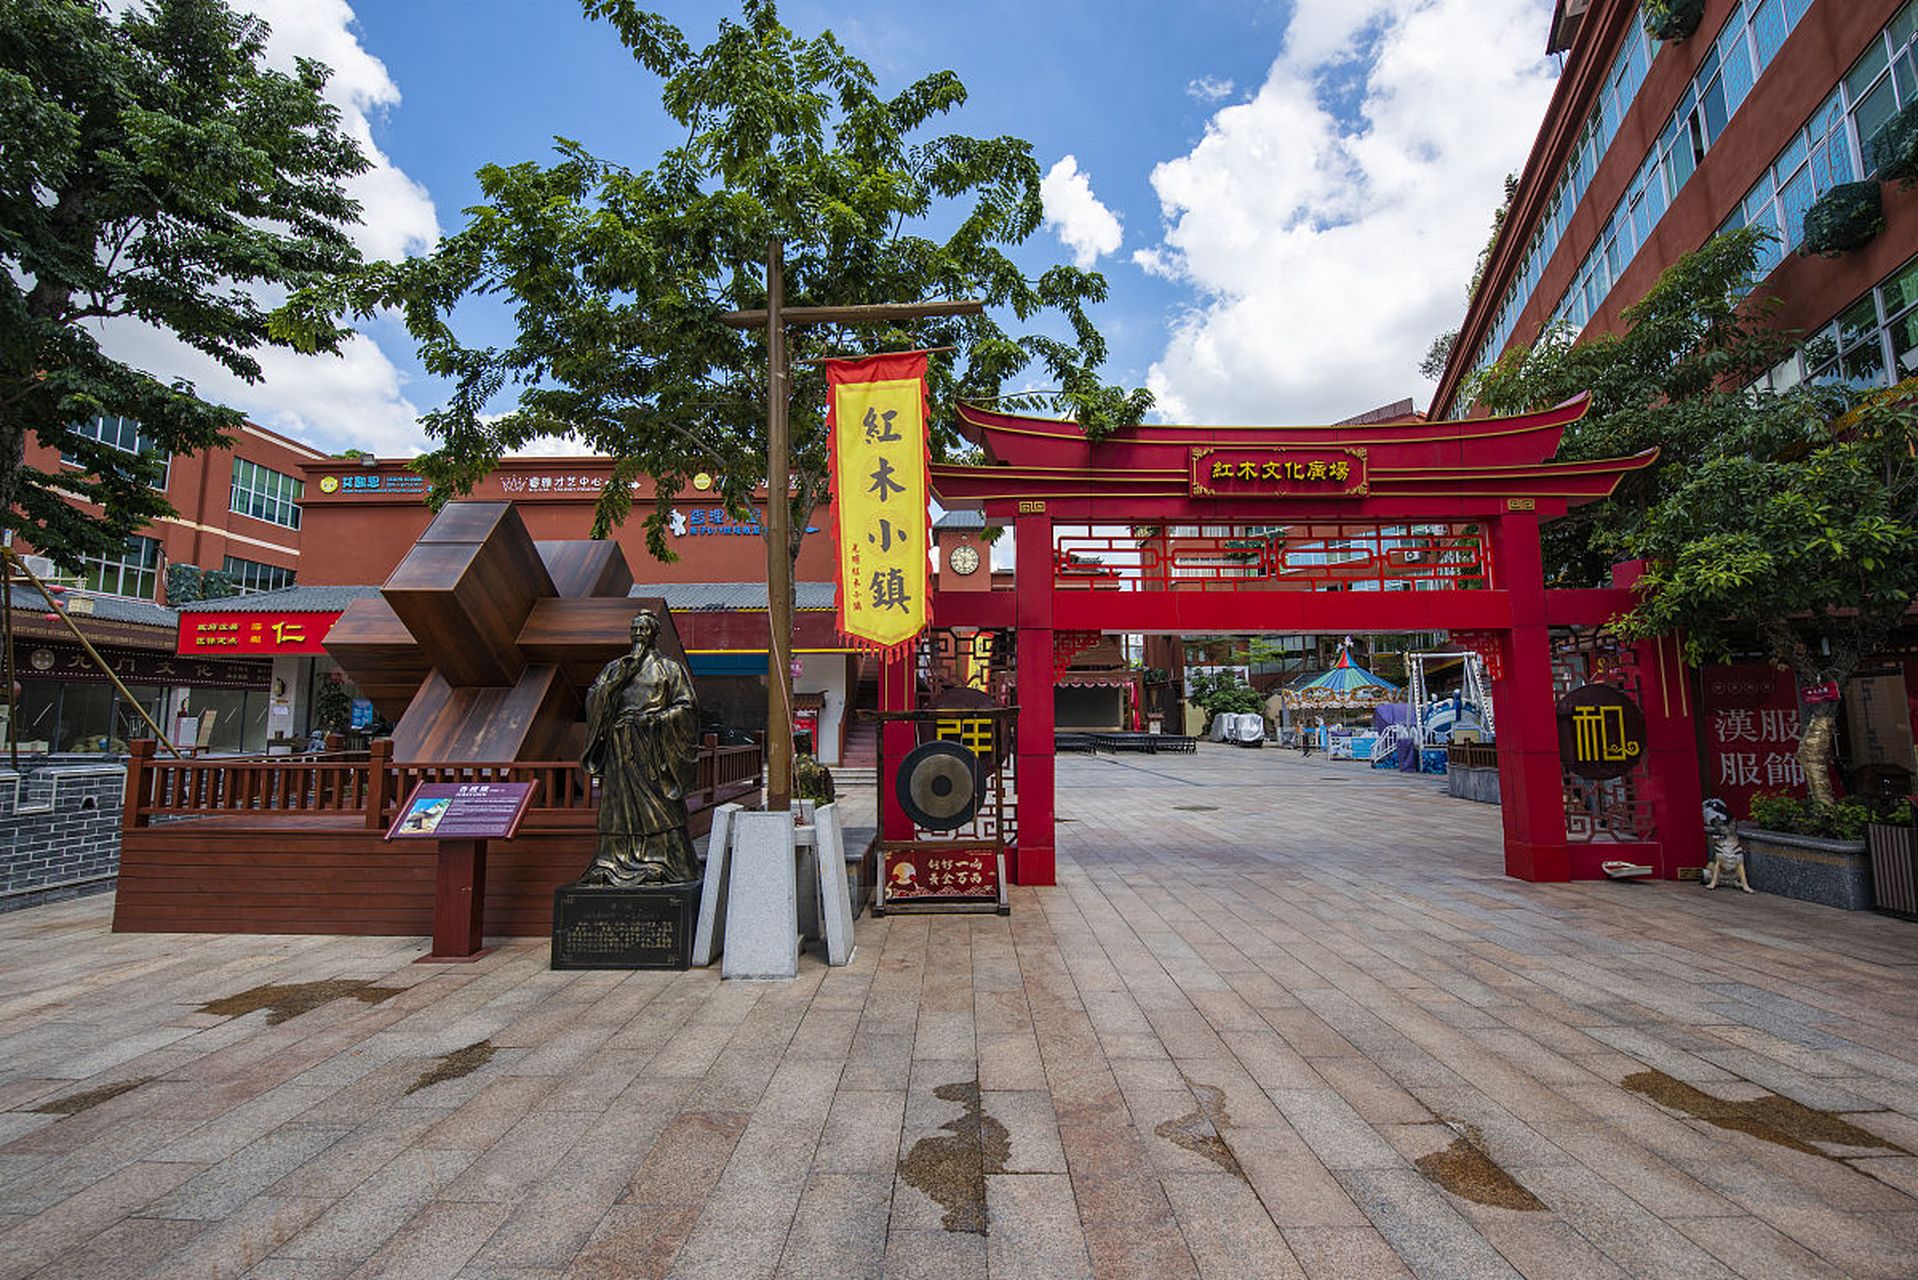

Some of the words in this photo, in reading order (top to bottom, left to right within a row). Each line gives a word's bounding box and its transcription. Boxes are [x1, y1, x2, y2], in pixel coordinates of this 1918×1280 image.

[1212, 460, 1350, 481] 紅木文化廣場
[863, 406, 911, 614] 紅木小鎮
[272, 621, 306, 644] 仁
[1714, 708, 1801, 742] 漢服
[1720, 752, 1805, 787] 服飾
